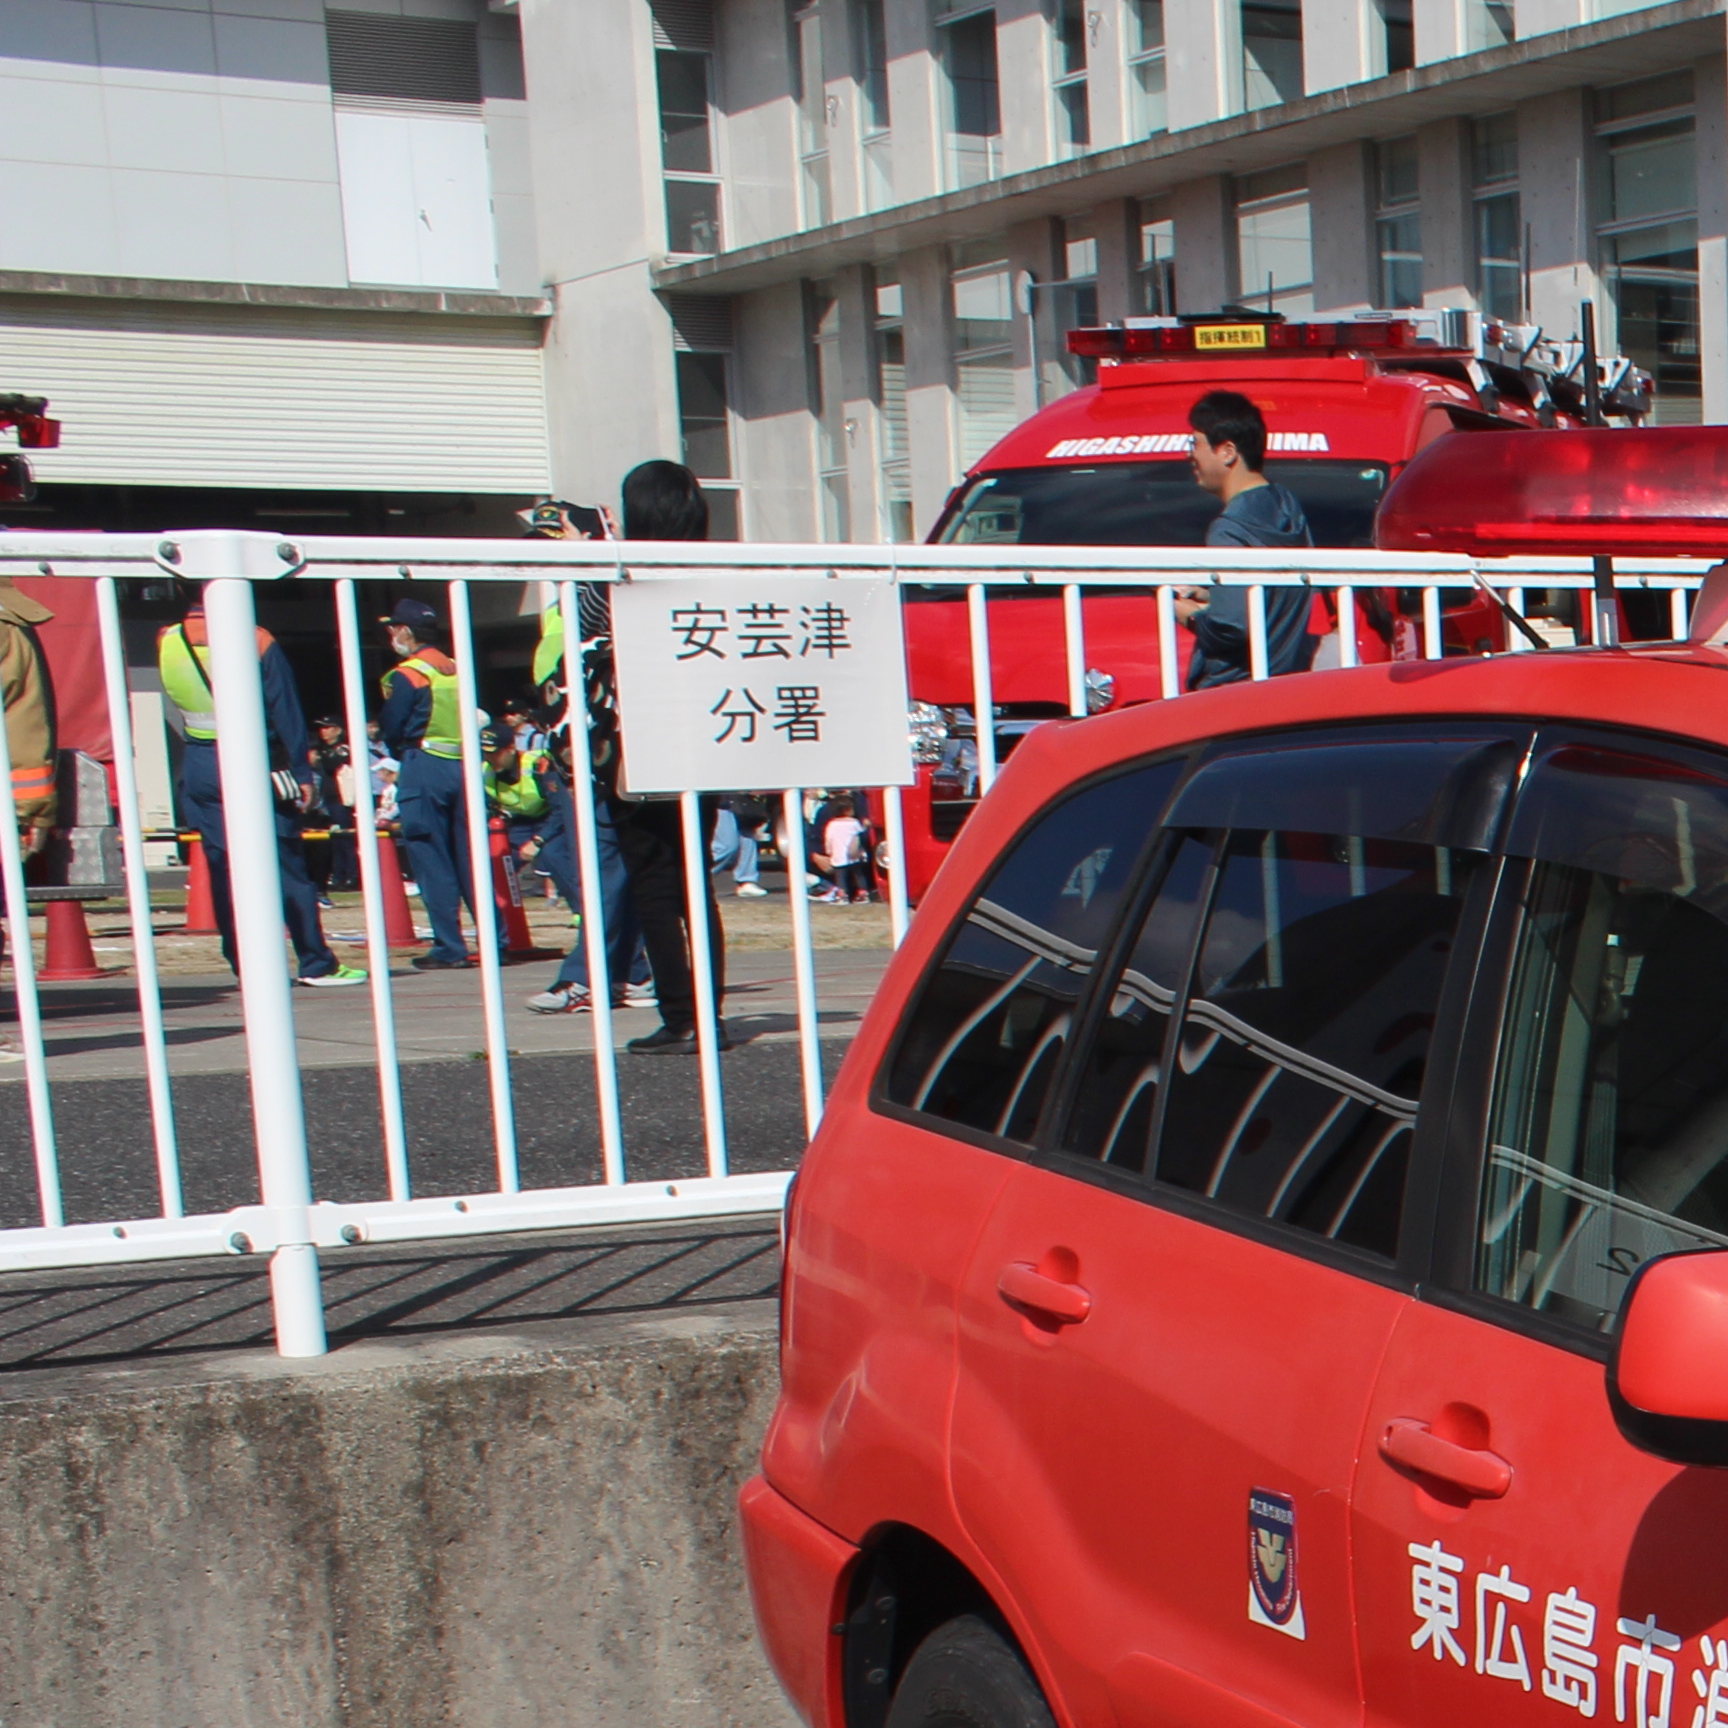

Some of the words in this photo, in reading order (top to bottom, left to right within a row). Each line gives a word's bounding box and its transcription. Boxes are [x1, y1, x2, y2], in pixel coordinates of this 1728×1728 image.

[670, 602, 852, 660] 安芸津
[709, 686, 826, 743] 分署
